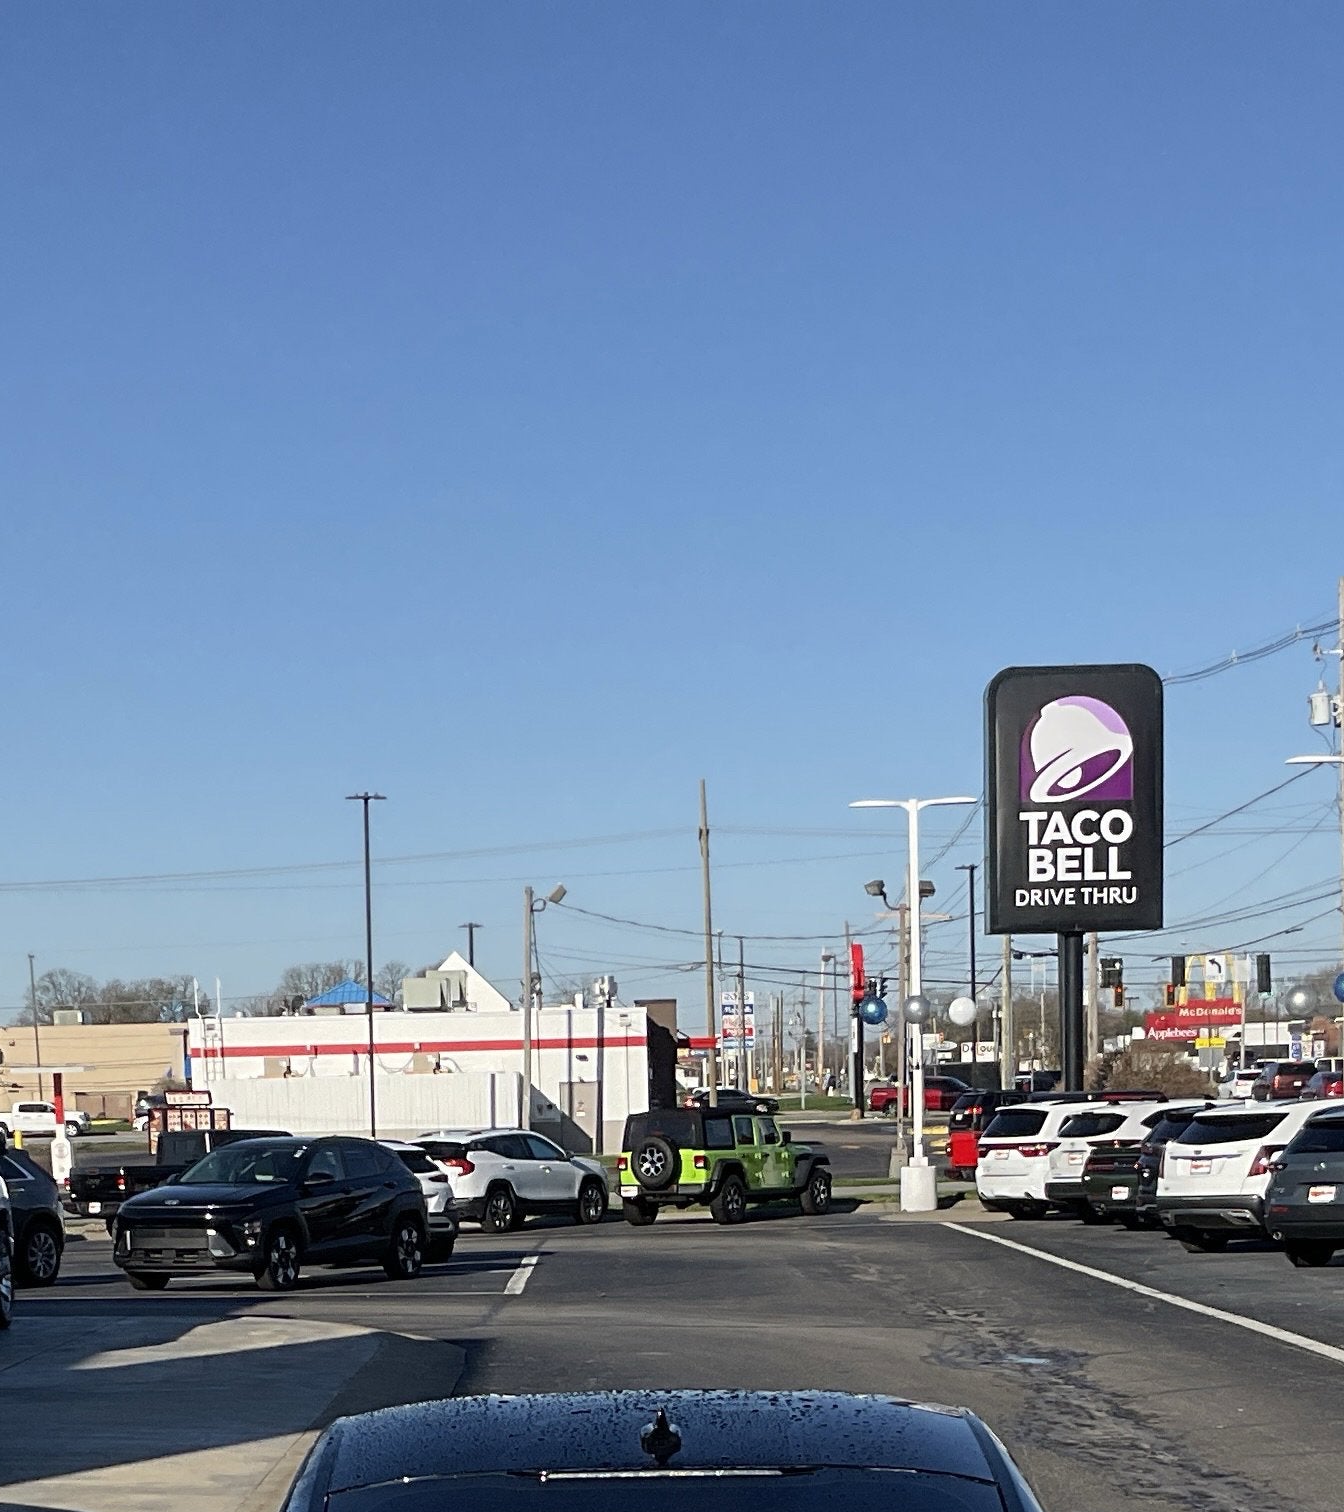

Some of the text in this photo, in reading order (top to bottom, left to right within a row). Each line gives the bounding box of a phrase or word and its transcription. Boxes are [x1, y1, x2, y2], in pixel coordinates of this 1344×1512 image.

[1019, 808, 1133, 845] TACO
[1028, 846, 1132, 882] BELL
[1015, 886, 1137, 907] DRIVE THRU
[1179, 1006, 1243, 1017] McDonald's
